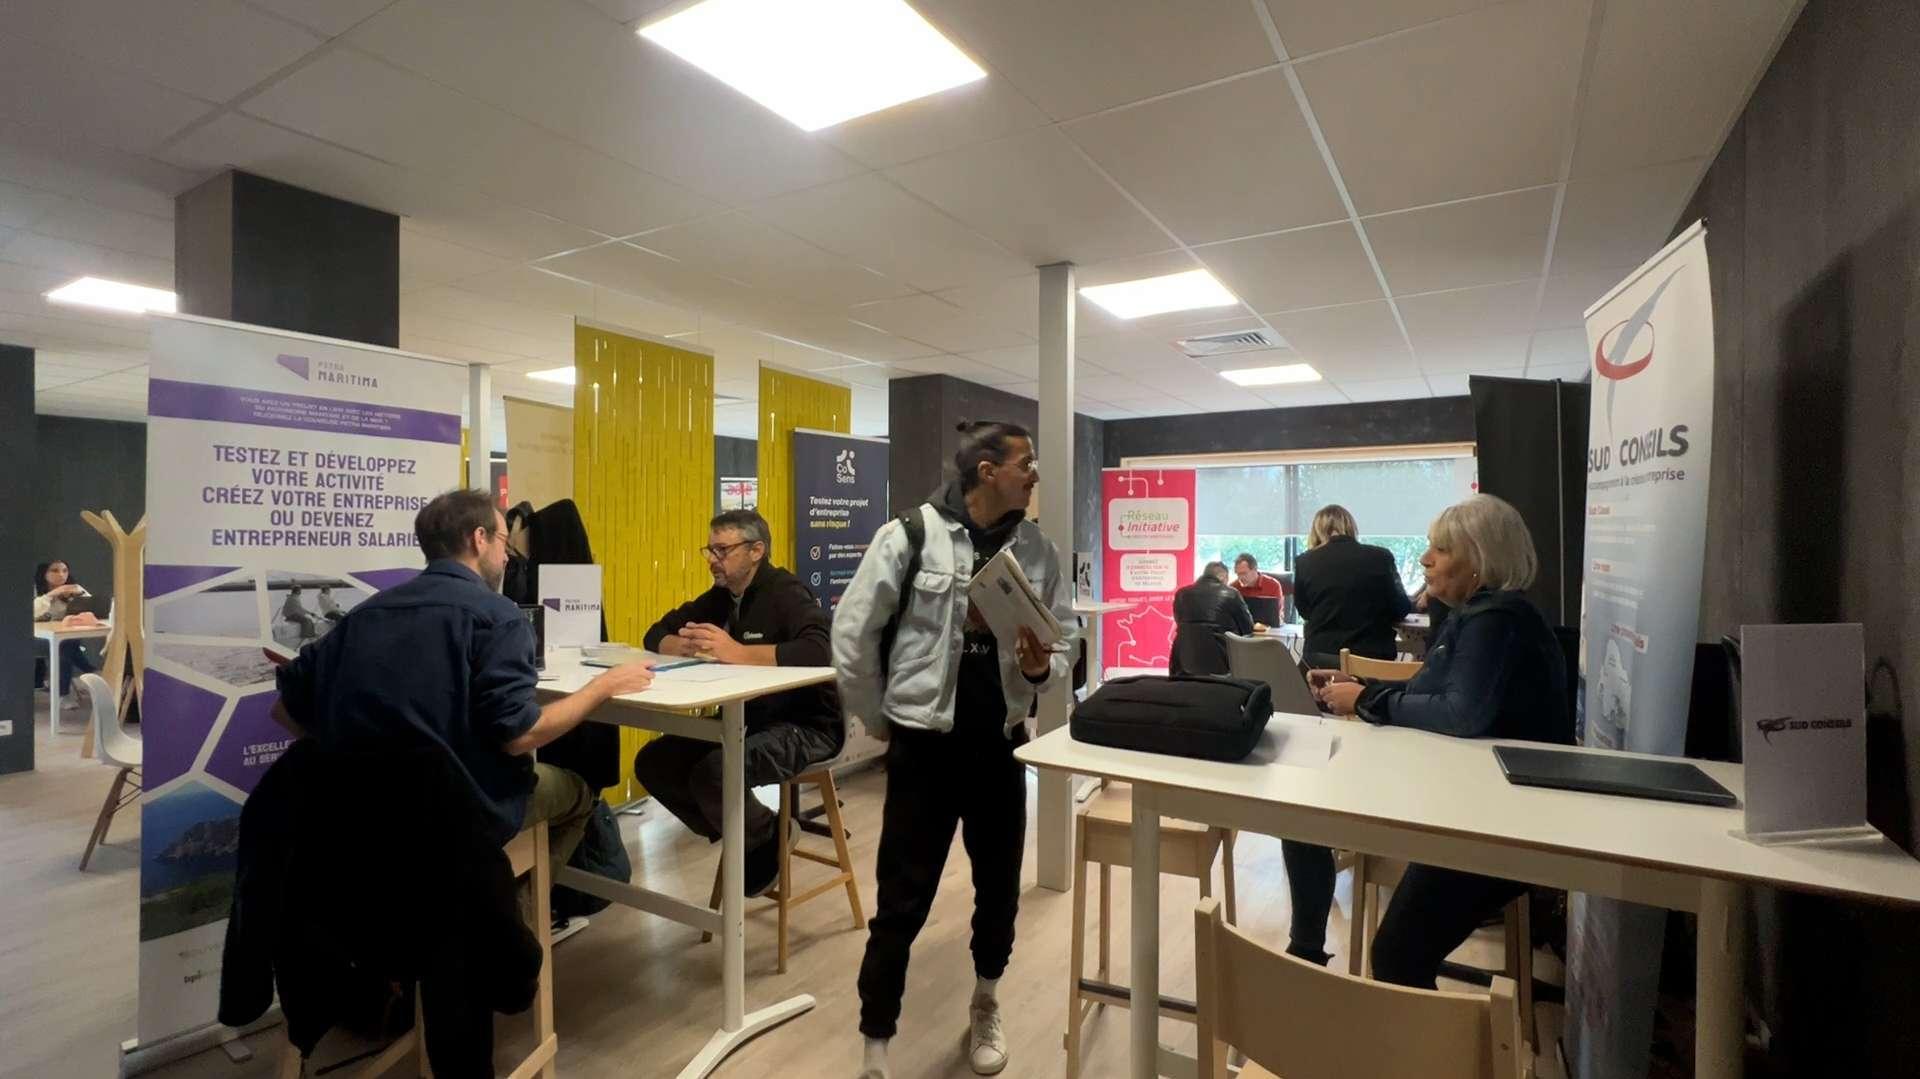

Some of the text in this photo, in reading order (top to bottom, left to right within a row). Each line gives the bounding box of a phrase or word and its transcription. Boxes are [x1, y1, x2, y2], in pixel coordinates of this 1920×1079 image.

[318, 371, 378, 388] MARITIMA
[213, 445, 416, 474] TESTEZ ET DÉVELOPPEZ
[1588, 446, 1611, 473] SUD
[836, 463, 847, 473] Co
[252, 468, 384, 491] VOTRE ACTIVITÉ
[836, 473, 855, 484] Sens
[202, 484, 428, 511] CRÉEZ VOTRE ENTREPRISE
[809, 496, 869, 508] Testez votre projet
[270, 510, 374, 528] OU DEVENEZ
[809, 508, 850, 517] d'entreprise
[1128, 509, 1169, 522] Réseau
[1127, 521, 1180, 533] Initiative
[212, 529, 351, 546] ENTREPRENEUR
[1790, 720, 1808, 730] SUD
